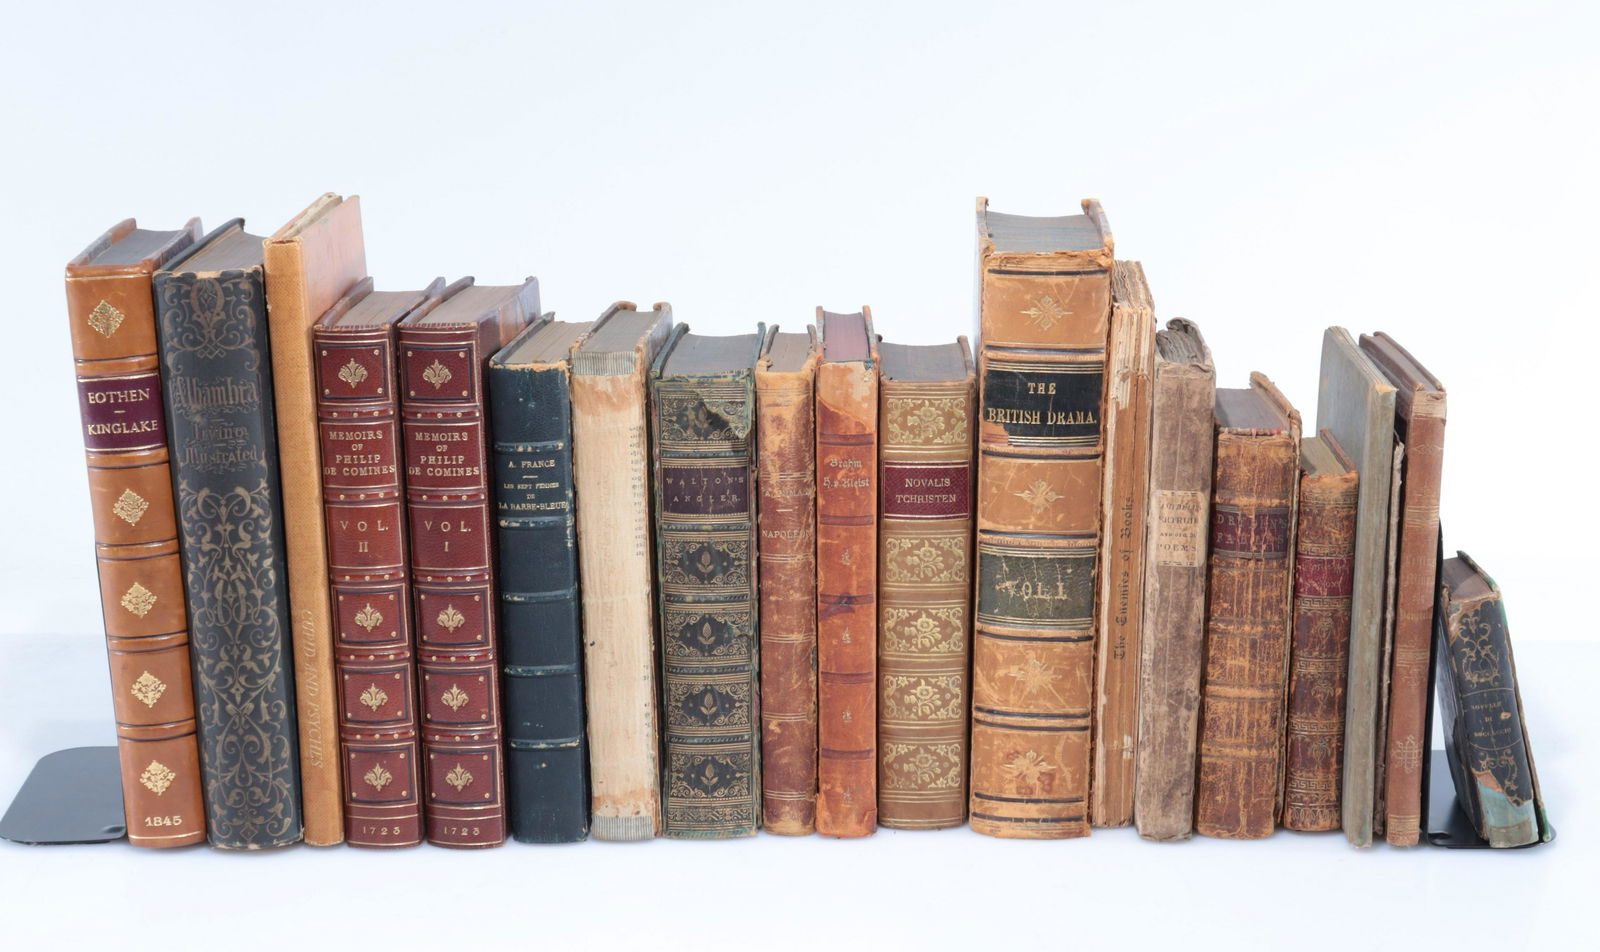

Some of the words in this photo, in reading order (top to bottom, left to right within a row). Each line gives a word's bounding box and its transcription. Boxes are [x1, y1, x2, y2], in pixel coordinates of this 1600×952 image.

[1028, 382, 1057, 395] THE
[88, 388, 150, 404] EOTHEN
[987, 407, 1041, 425] BRITISH
[1046, 410, 1097, 426] DRAMA.
[88, 419, 159, 436] KINGLAKE
[329, 430, 384, 441] MEMOIRS
[415, 431, 469, 442] MEMOIRS
[351, 443, 364, 452] OF
[436, 444, 449, 453] OF
[335, 454, 382, 465] PHILIP
[419, 455, 466, 465] PHILIP
[507, 460, 518, 470] A.
[521, 459, 557, 470] FRANCE
[323, 466, 340, 476] DE
[342, 464, 397, 476] COMINES
[408, 466, 422, 476] DE
[426, 466, 480, 476] COMINES
[665, 476, 745, 487] WALTON'S
[904, 477, 951, 488] NOVALIS
[895, 494, 957, 505] TCHRISTEN
[498, 502, 508, 510] LA
[1120, 495, 1135, 540] Books
[339, 520, 390, 533] VOL.
[424, 520, 472, 533] VOL.
[358, 541, 369, 554] II
[443, 541, 450, 553] I
[1122, 547, 1134, 561] of
[1115, 569, 1130, 627] Enemies
[1112, 635, 1127, 661] The
[144, 815, 183, 828] 1845
[362, 825, 402, 836] 1723
[443, 825, 480, 836] 1723
